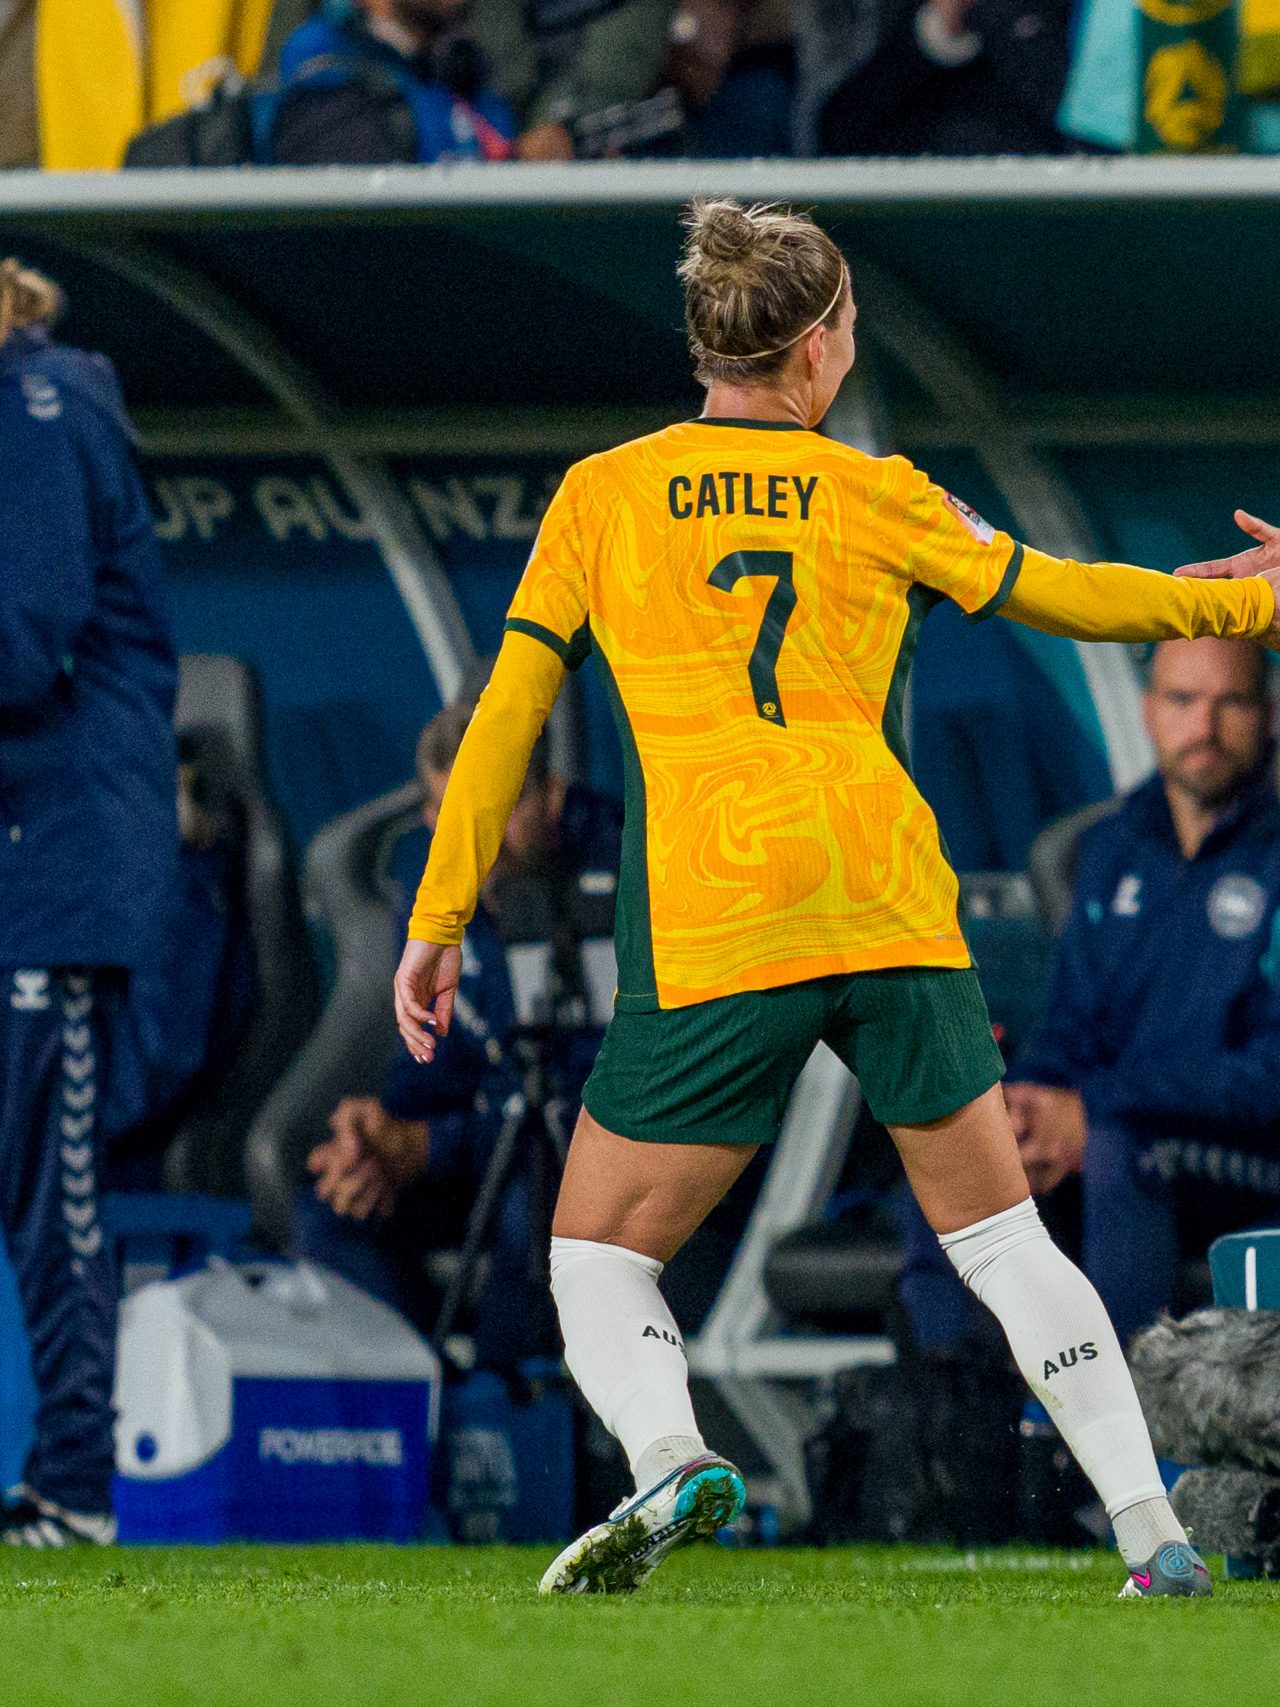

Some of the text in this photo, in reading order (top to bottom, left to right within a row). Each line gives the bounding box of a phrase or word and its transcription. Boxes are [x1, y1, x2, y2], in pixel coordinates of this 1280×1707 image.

[668, 472, 819, 520] CATLEY
[706, 550, 798, 728] 7
[1043, 1342, 1099, 1381] AUS
